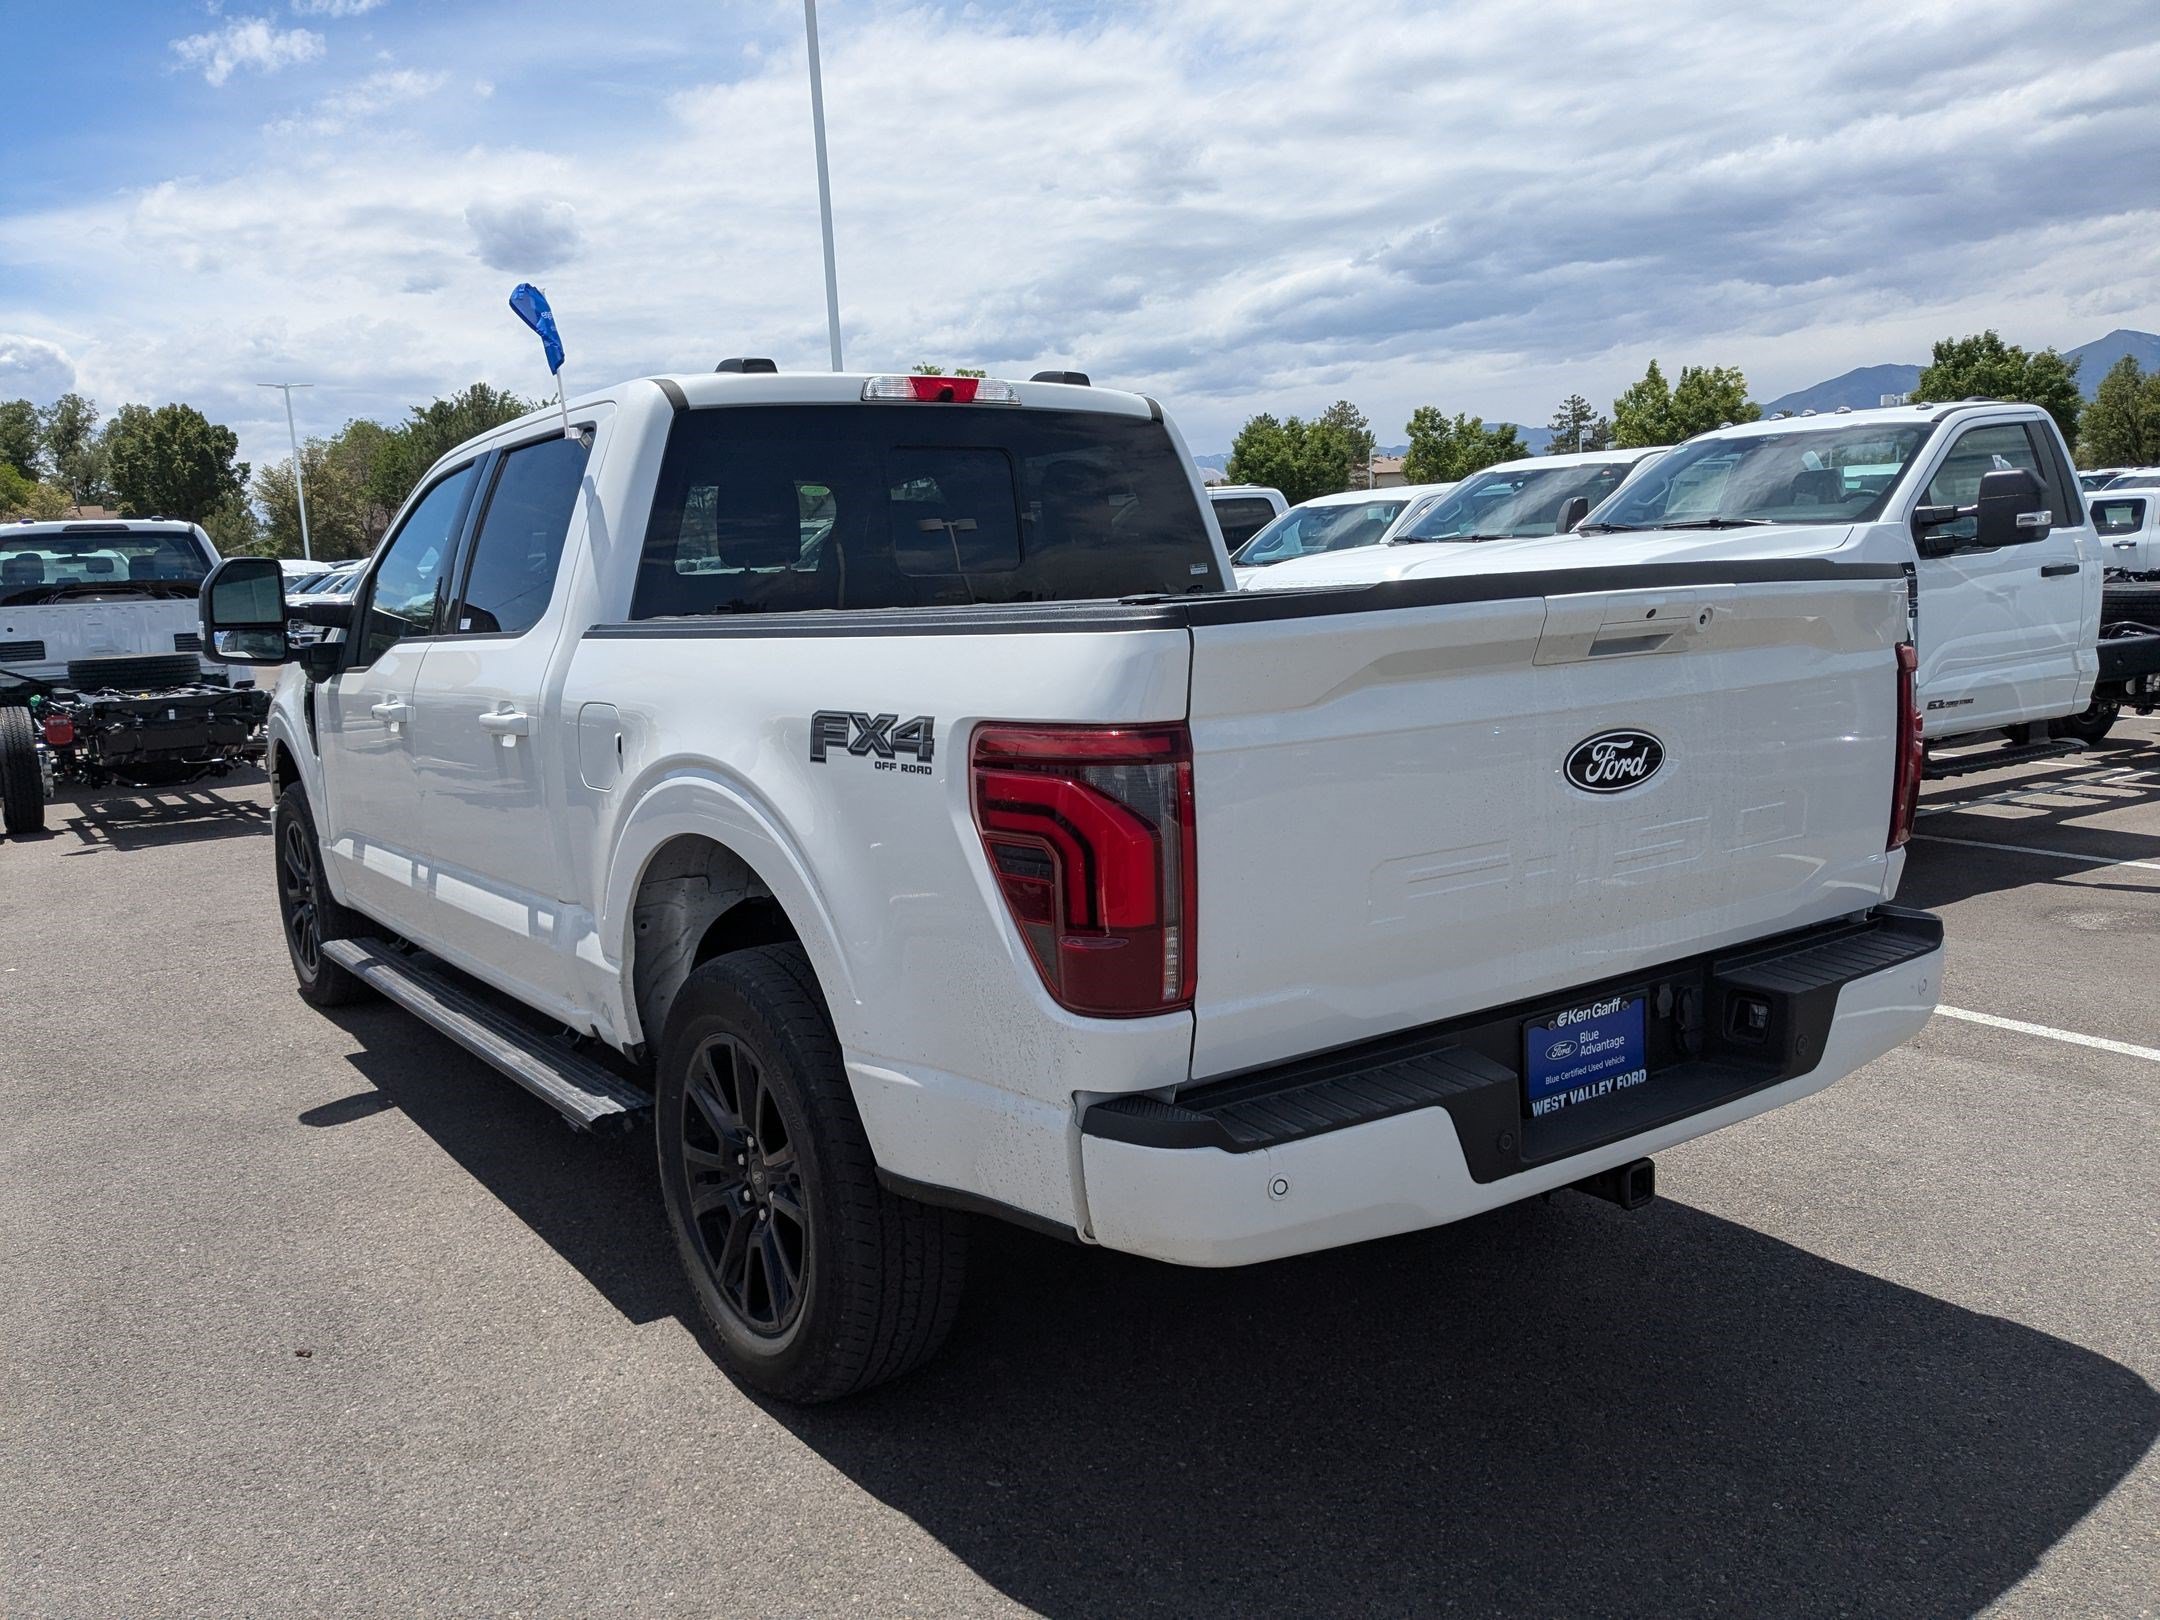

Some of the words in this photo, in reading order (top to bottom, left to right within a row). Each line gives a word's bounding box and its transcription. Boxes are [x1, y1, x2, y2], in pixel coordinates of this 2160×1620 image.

[810, 710, 935, 764] FX4
[874, 761, 897, 771] OFF
[901, 762, 932, 775] ROAD
[1585, 740, 1648, 782] Ford
[1567, 1008, 1591, 1025] Ken
[1592, 998, 1621, 1018] Garff
[1551, 1043, 1572, 1058] Ford
[1579, 1030, 1600, 1044] Blue
[1579, 1035, 1625, 1057] Advantage
[1545, 1074, 1560, 1085] Blue
[1561, 1064, 1587, 1081] Certified
[1588, 1062, 1604, 1073] Used
[1605, 1055, 1626, 1068] Vehicle
[1532, 1093, 1567, 1117] WEST
[1569, 1079, 1614, 1105] VALLEY
[1617, 1069, 1647, 1091] FORD
